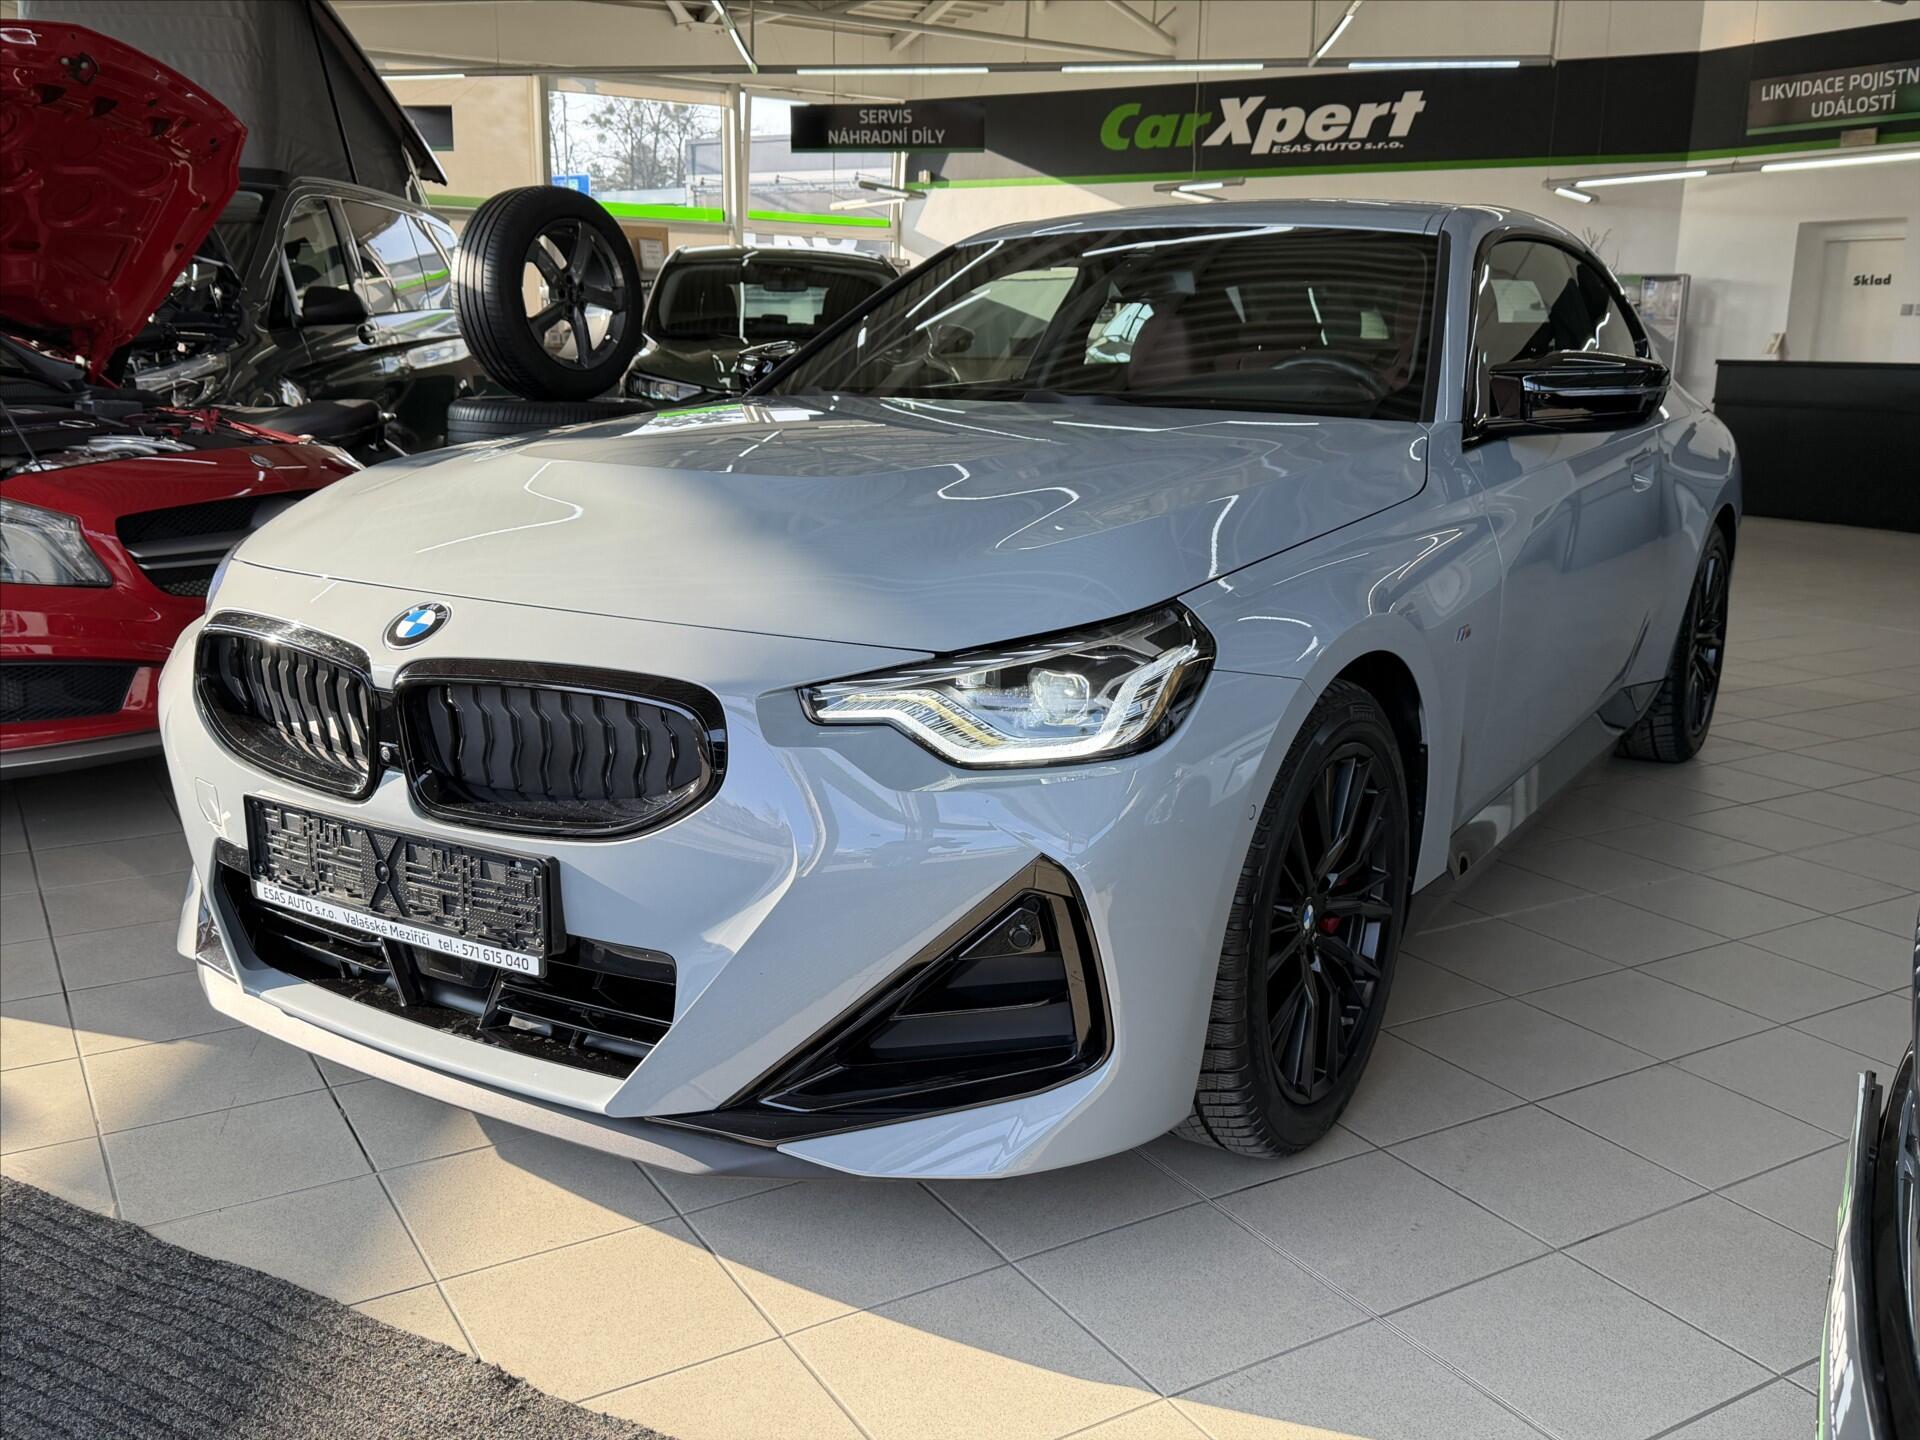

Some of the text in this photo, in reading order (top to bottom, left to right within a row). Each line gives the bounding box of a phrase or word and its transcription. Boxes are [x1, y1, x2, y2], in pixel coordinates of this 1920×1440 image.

[1761, 67, 1920, 101] LIKVIDACE POJISTN
[1811, 91, 1896, 118] UDÁLOSTÍ
[859, 109, 912, 124] SERVIS
[1100, 90, 1426, 155] CarXpert
[827, 127, 945, 144] NÁHRADNÍ DÍLY
[1272, 141, 1404, 154] ESAS AUTO s.r.o.
[1853, 273, 1892, 286] Sklad
[263, 887, 286, 904] ESAS
[288, 895, 313, 913] AUTO
[315, 905, 337, 920] s.r.o.
[343, 911, 387, 935] Valašské
[438, 938, 460, 954] tel.:
[462, 943, 480, 958] 571
[483, 948, 502, 964] 615
[505, 954, 529, 970] 040
